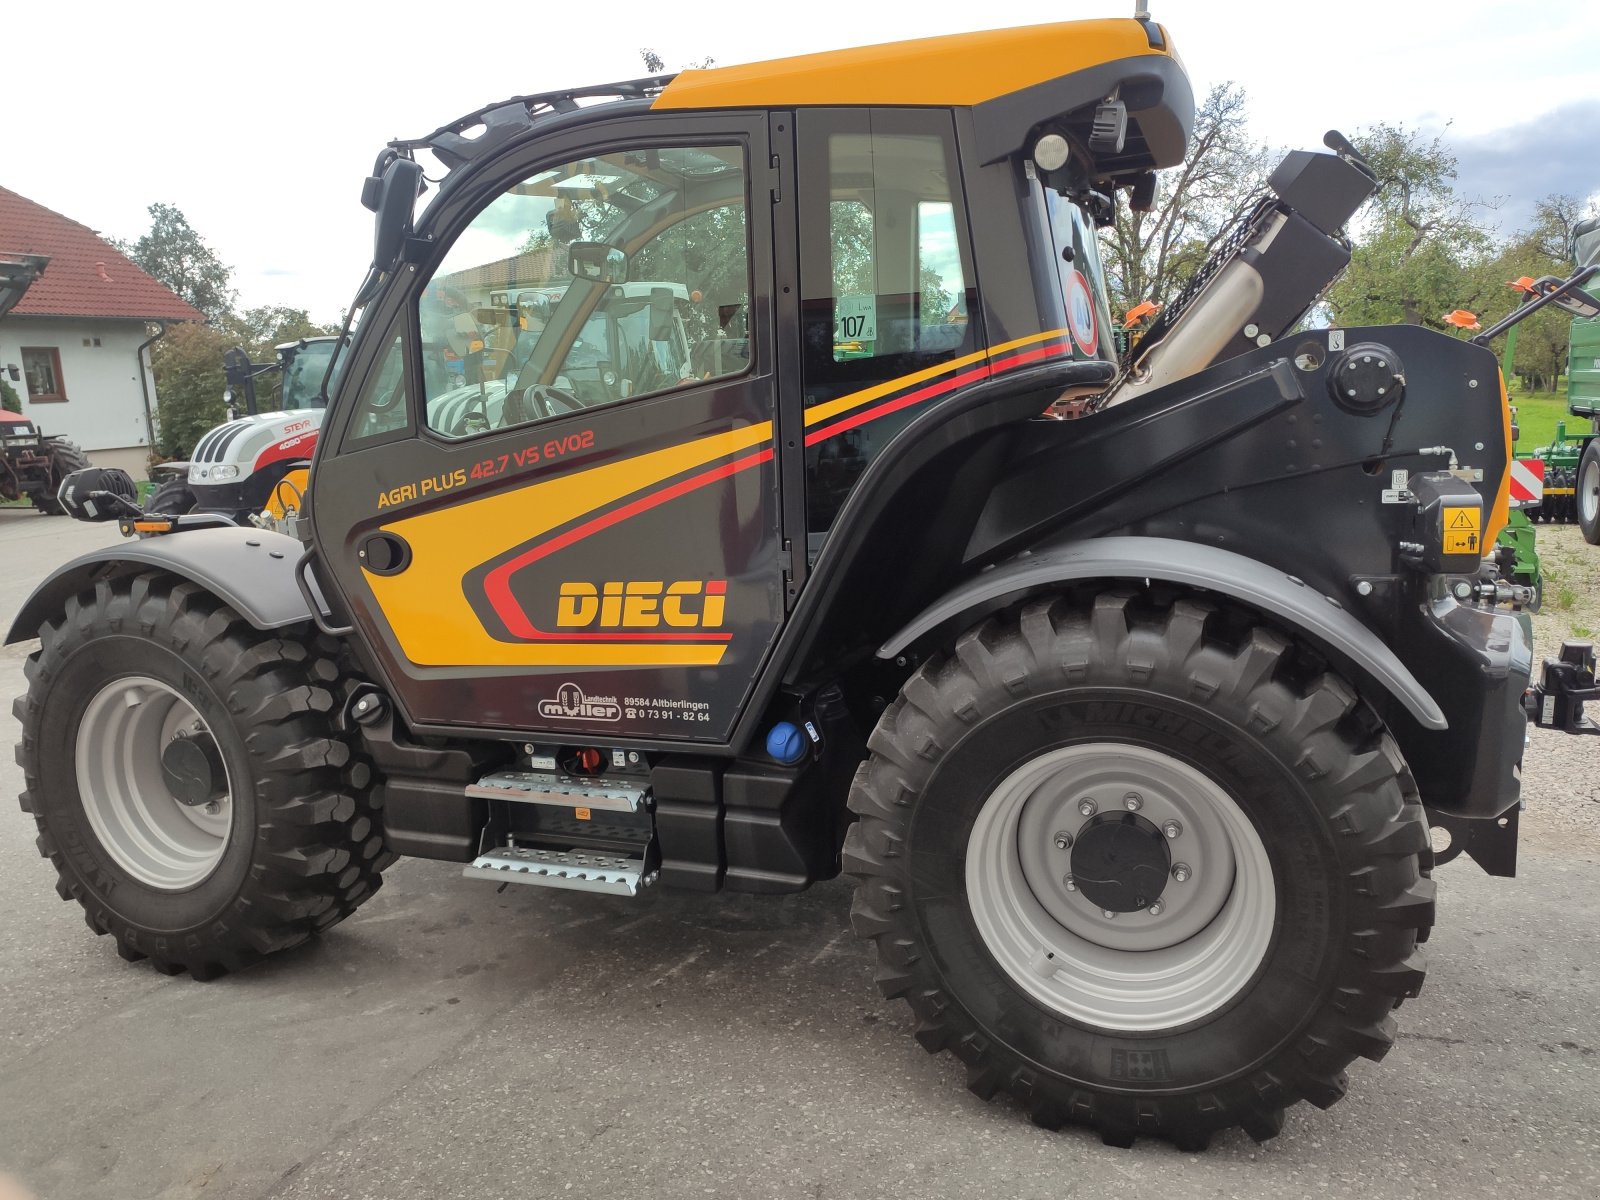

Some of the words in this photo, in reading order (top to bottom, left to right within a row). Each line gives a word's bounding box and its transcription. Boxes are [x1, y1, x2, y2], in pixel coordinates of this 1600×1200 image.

[841, 315, 866, 338] 107
[284, 420, 311, 434] STEYR
[377, 483, 417, 509] AGRI
[421, 469, 467, 496] PLUS
[470, 454, 510, 480] 42.7
[513, 446, 540, 467] VS
[584, 695, 617, 704] Landtechnik
[624, 697, 650, 707] 89584
[651, 698, 709, 711] Altbierlingen
[638, 710, 645, 718] 0
[647, 710, 660, 719] 73
[661, 711, 673, 720] 91
[682, 711, 695, 721] 82
[697, 712, 710, 722] 64
